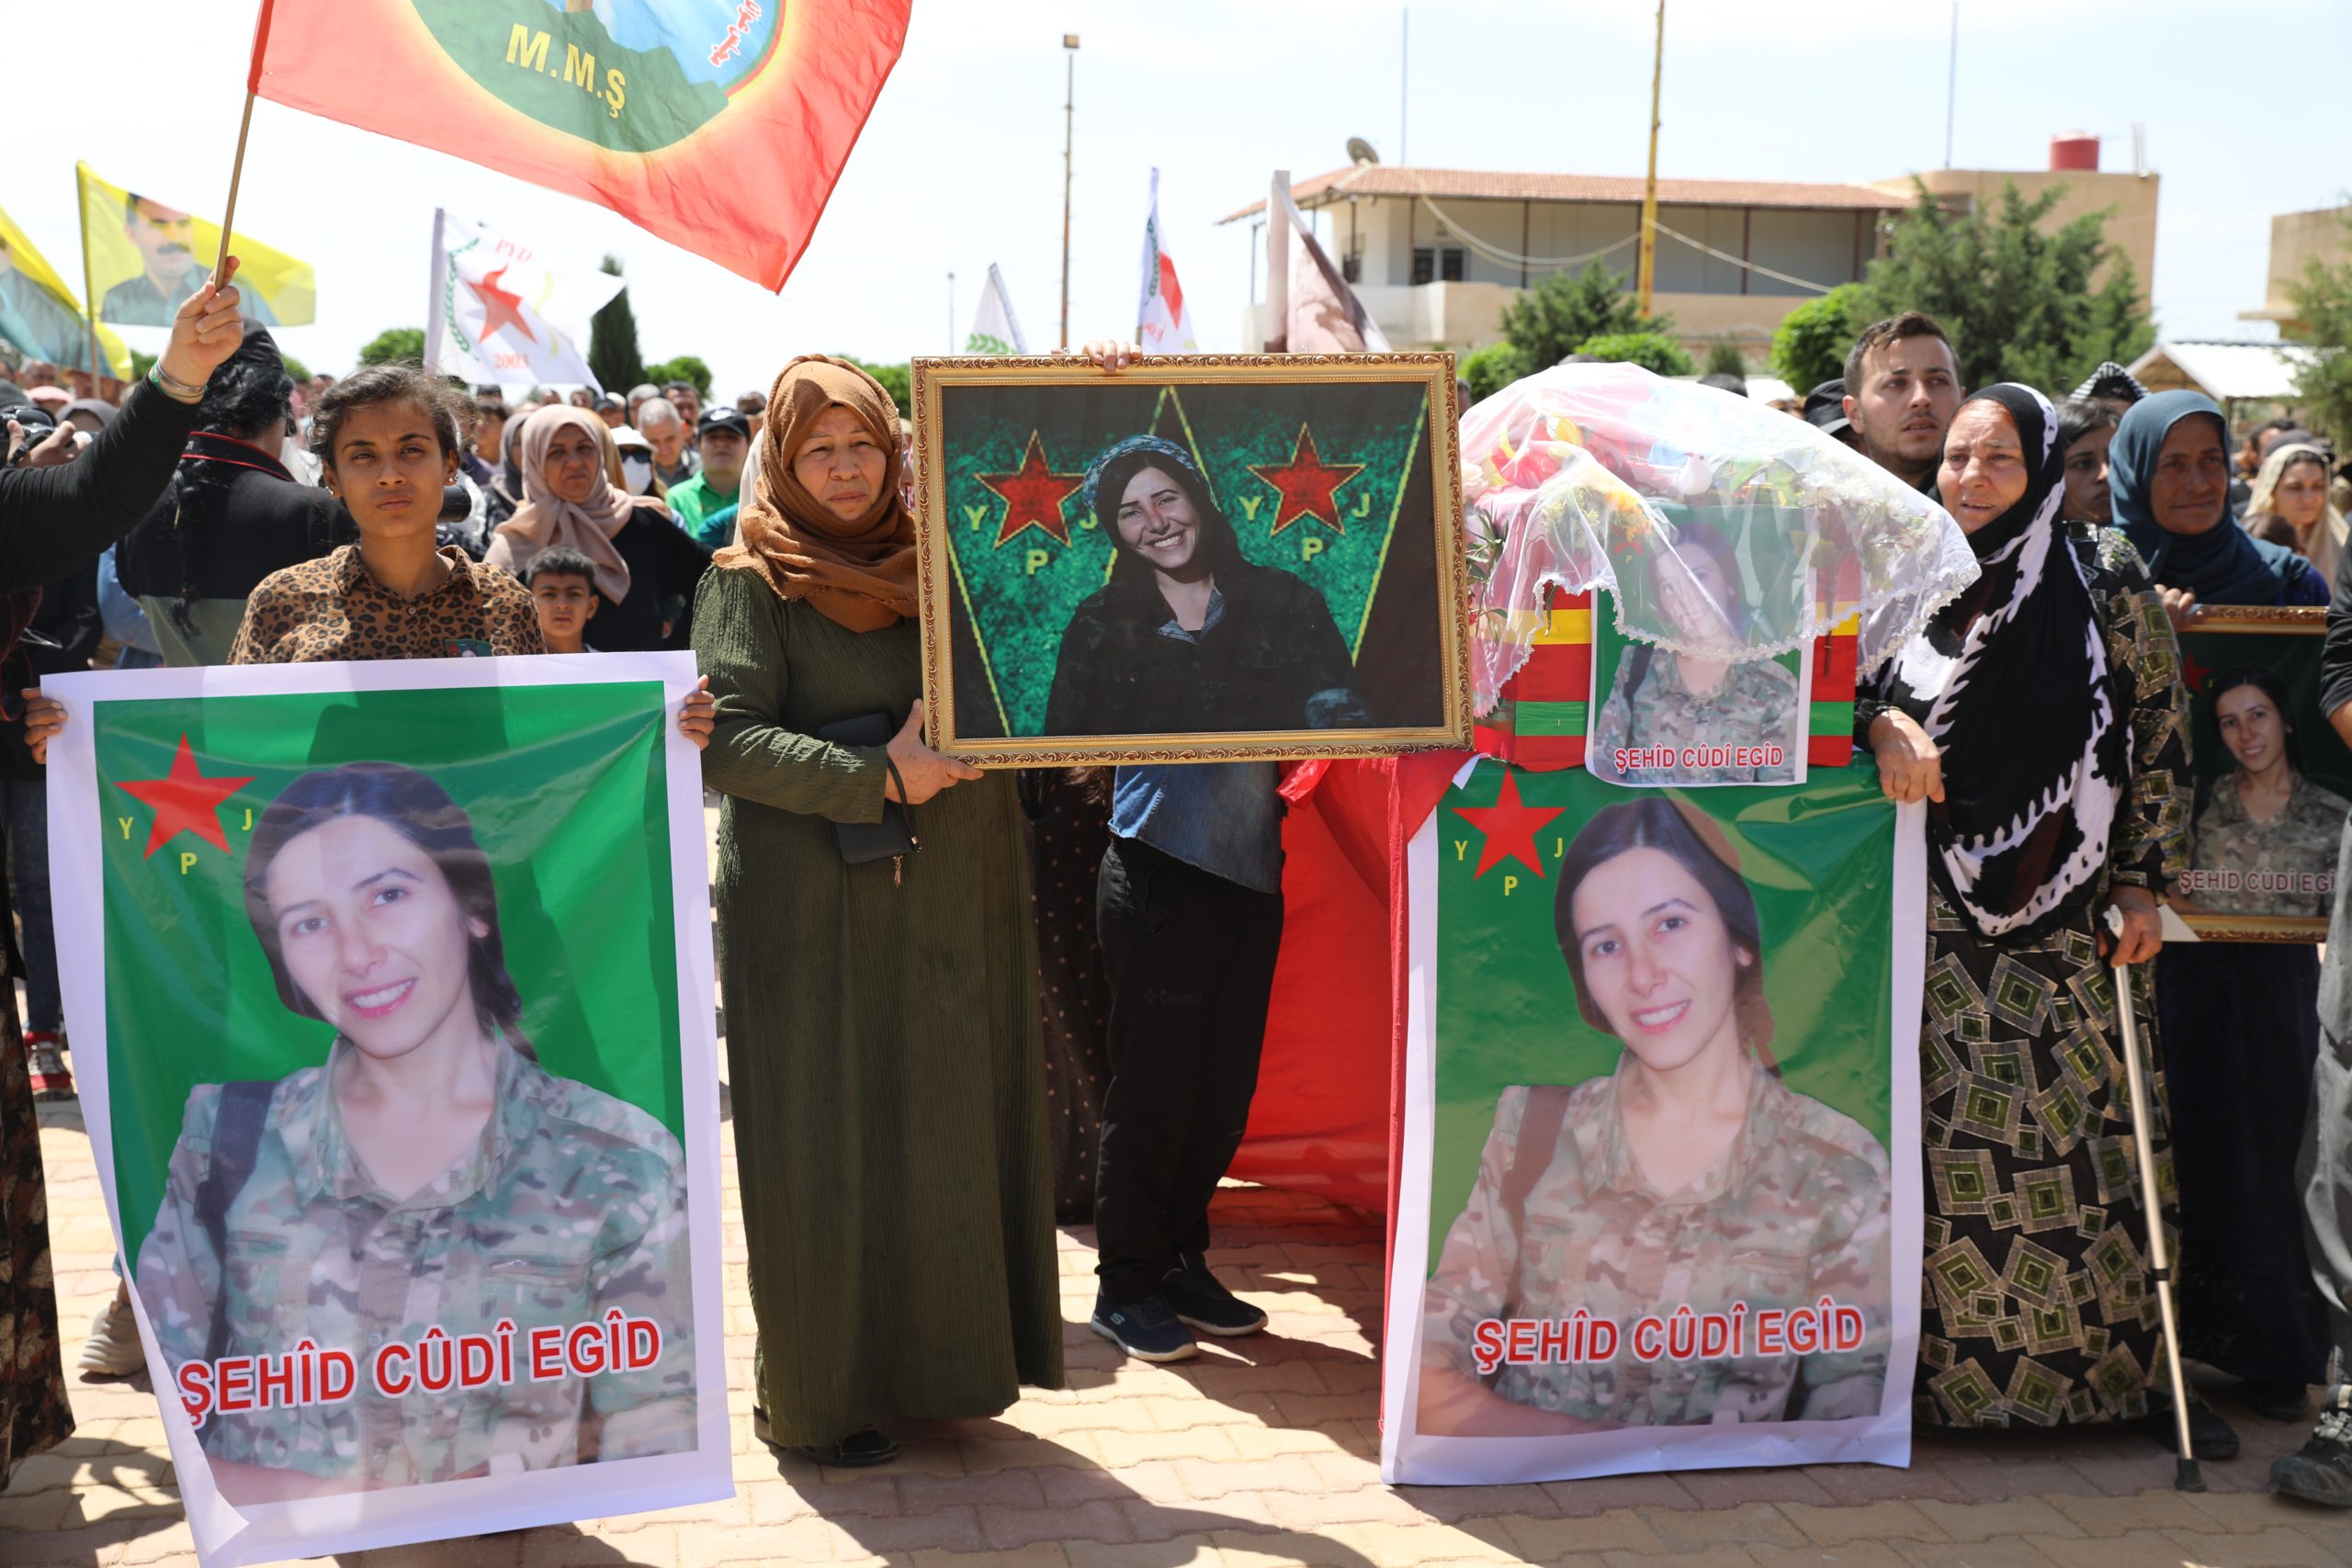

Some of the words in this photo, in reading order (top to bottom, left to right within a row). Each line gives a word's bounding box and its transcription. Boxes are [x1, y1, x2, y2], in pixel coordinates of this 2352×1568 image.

[506, 23, 626, 118] M.M.Ş
[494, 239, 533, 263] PYD
[492, 353, 530, 369] 2003
[1238, 496, 1263, 521] Y
[1351, 492, 1370, 517] J
[964, 505, 989, 531] Y
[1079, 508, 1098, 530] J
[1027, 549, 1048, 575] P
[1302, 537, 1323, 562] P
[1614, 743, 1676, 773] ŞEHÎD
[1681, 742, 1732, 768] CÛDÎ
[1736, 741, 1783, 767] EGÎD
[118, 817, 133, 840] Y
[242, 808, 253, 830] J
[1454, 840, 1468, 861] Y
[1554, 838, 1563, 858] J
[181, 852, 198, 874] P
[1504, 875, 1518, 897] P
[2180, 868, 2240, 893] ŞEHÎD
[2301, 869, 2336, 892] EGÎ
[1474, 1309, 1619, 1372] ŞEHÎD
[1634, 1303, 1747, 1360] CÛDÎ
[1758, 1296, 1863, 1355] EGÎD
[179, 1339, 356, 1427] ŞEHÎD
[376, 1320, 514, 1395] CÛDÎ
[531, 1309, 660, 1379] EGÎD
